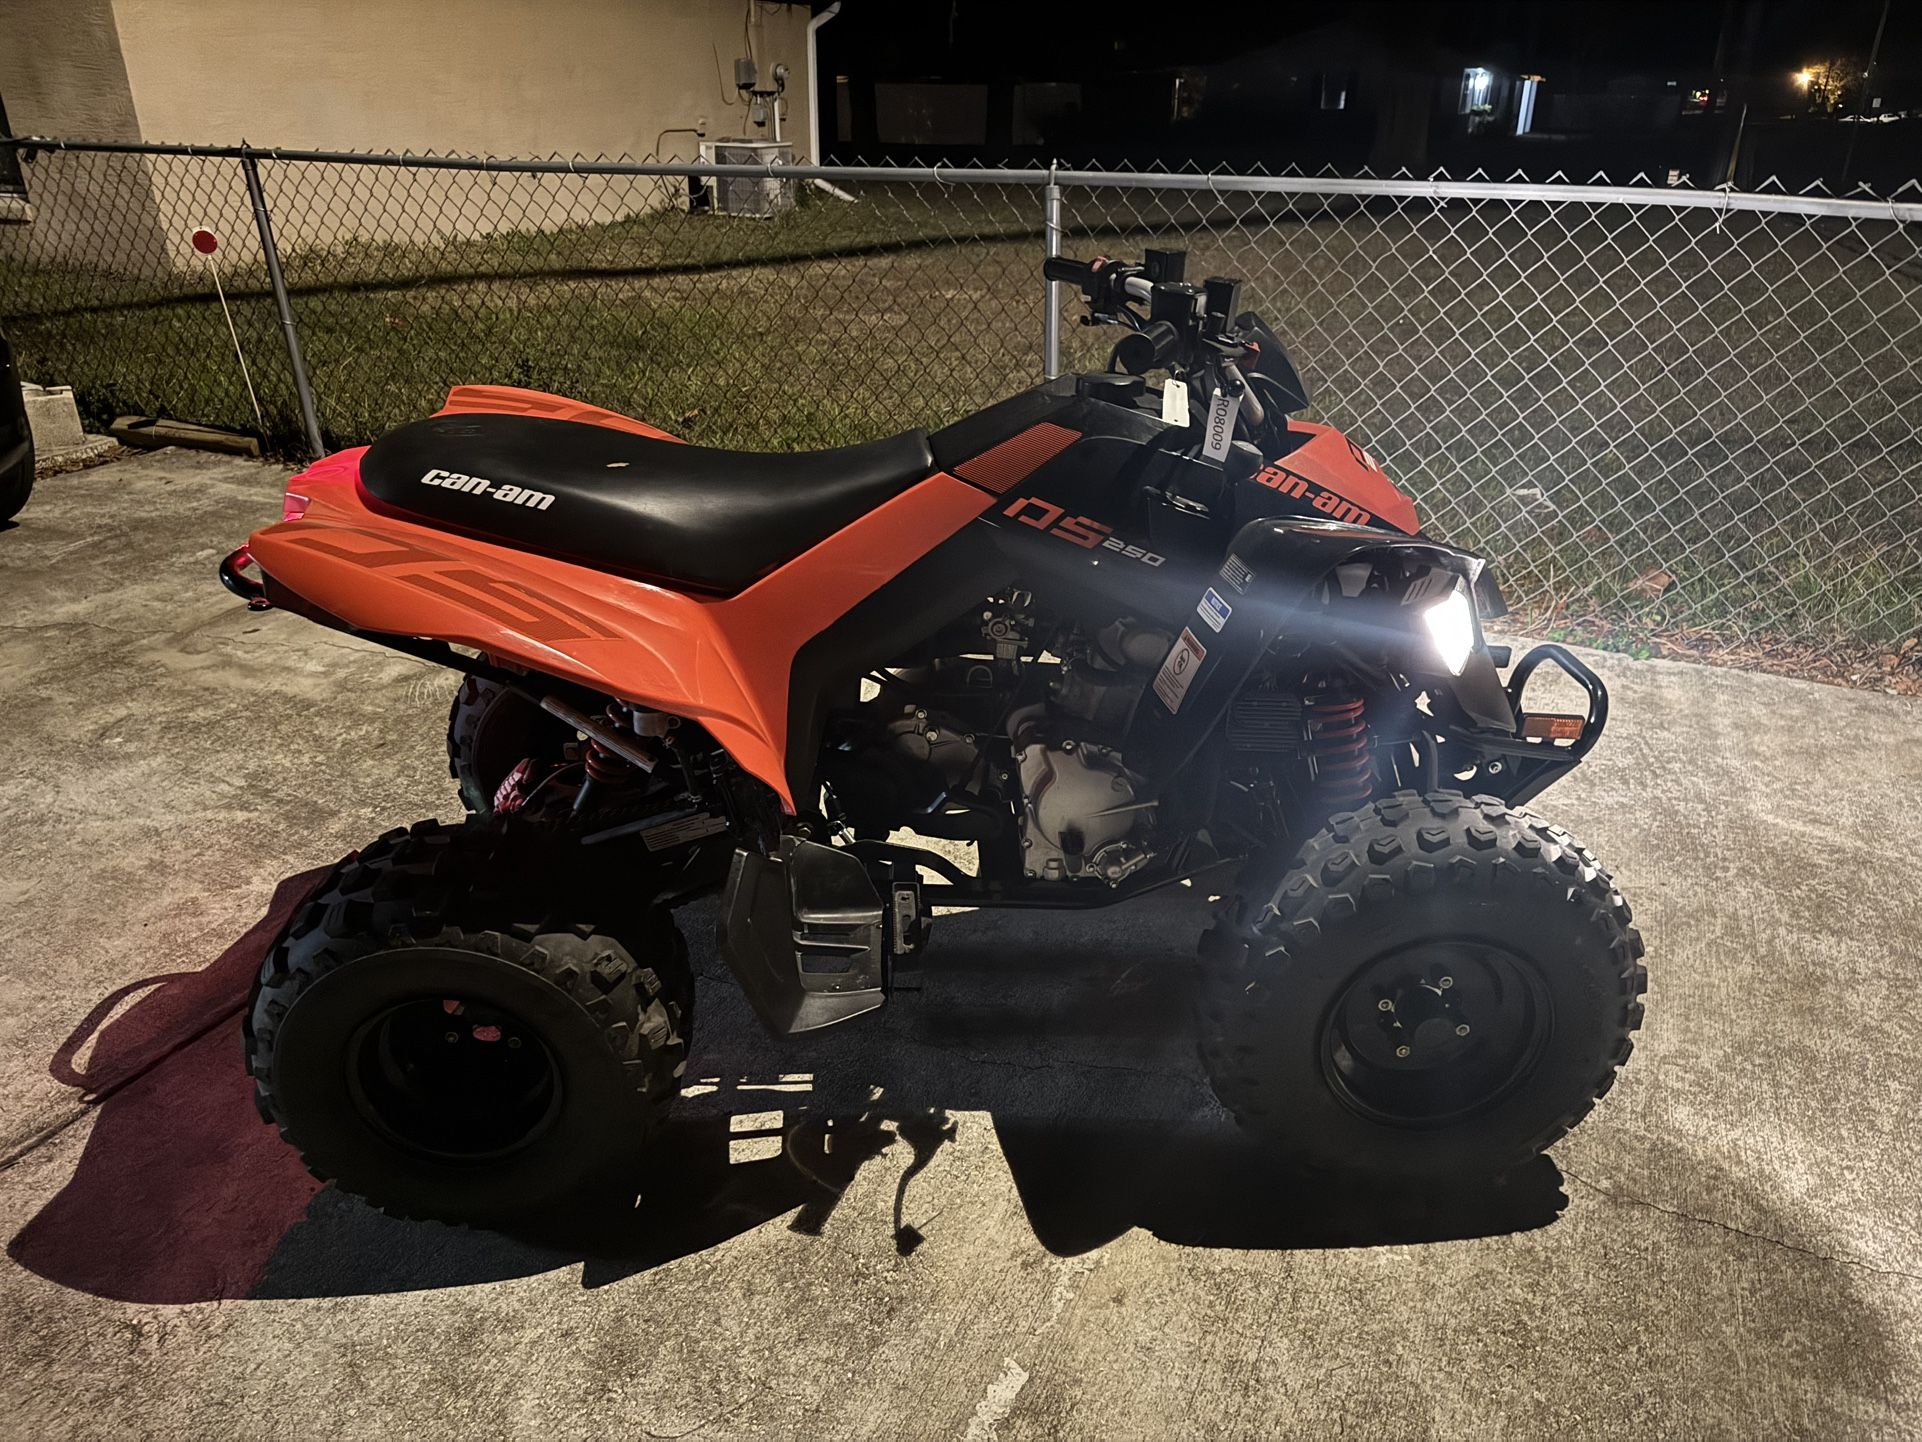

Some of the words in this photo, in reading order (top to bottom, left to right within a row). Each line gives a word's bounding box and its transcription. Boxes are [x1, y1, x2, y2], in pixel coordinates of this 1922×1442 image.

[1211, 398, 1230, 451] R08009
[420, 469, 556, 511] can-am
[1250, 464, 1371, 526] an-am
[1002, 496, 1114, 549] DS
[1101, 536, 1167, 567] 250
